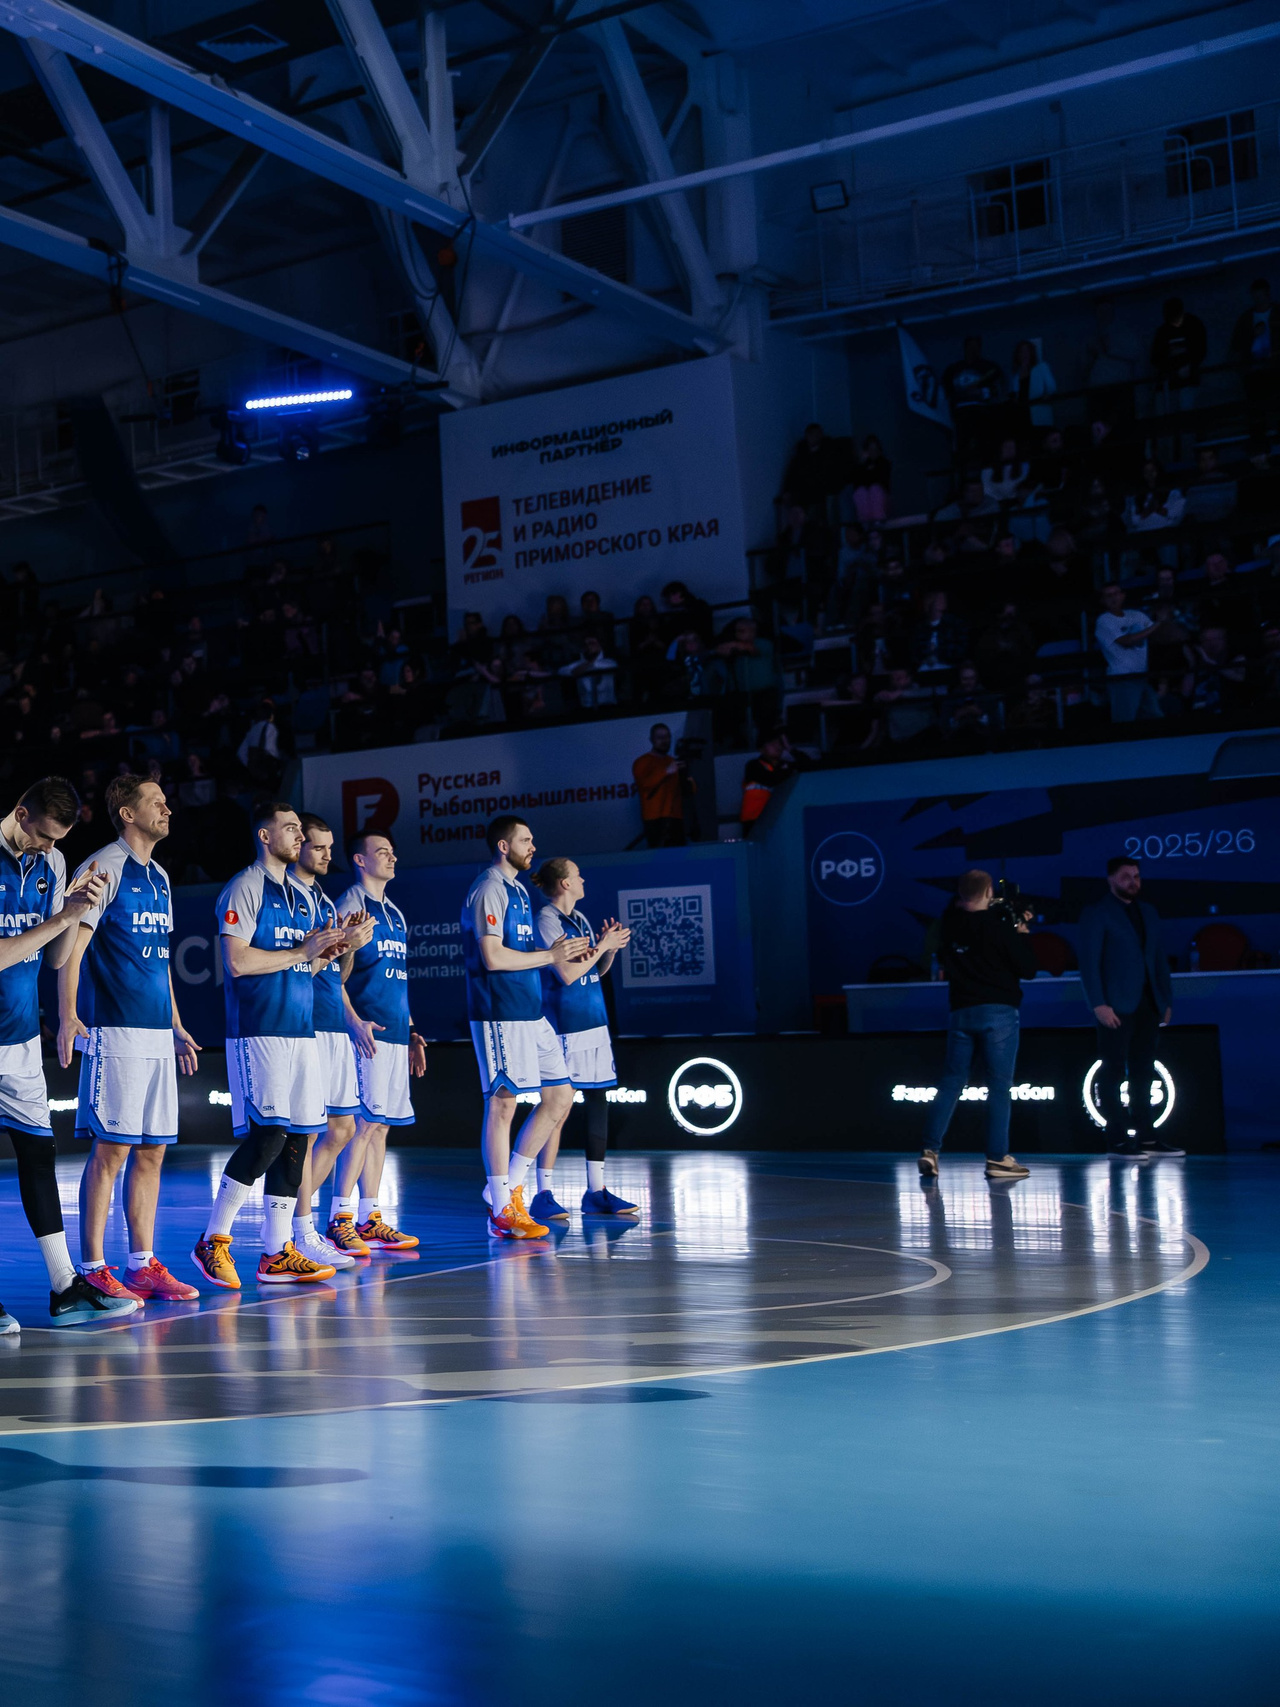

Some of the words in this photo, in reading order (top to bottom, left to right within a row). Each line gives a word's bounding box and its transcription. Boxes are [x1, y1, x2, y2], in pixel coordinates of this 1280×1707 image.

[491, 408, 673, 459] ИНФОРМАЦИОННЫЙ
[540, 437, 623, 465] ПАРТНЁР
[512, 474, 652, 516] ТЕЛЕВИДЕНИЕ
[513, 525, 527, 543] И
[532, 512, 598, 539] РАДИО
[515, 527, 662, 569] ПРИМОРСКОГО
[668, 518, 719, 544] КРАЯ
[464, 567, 505, 585] РЕГИОН
[418, 770, 501, 797] Русская
[419, 782, 640, 819] Рыбопромышленная
[421, 822, 488, 845] Компа
[1124, 828, 1256, 860] 2025/26
[821, 857, 876, 880] РФБ
[406, 921, 461, 941] усская
[678, 1084, 734, 1109] РФБ
